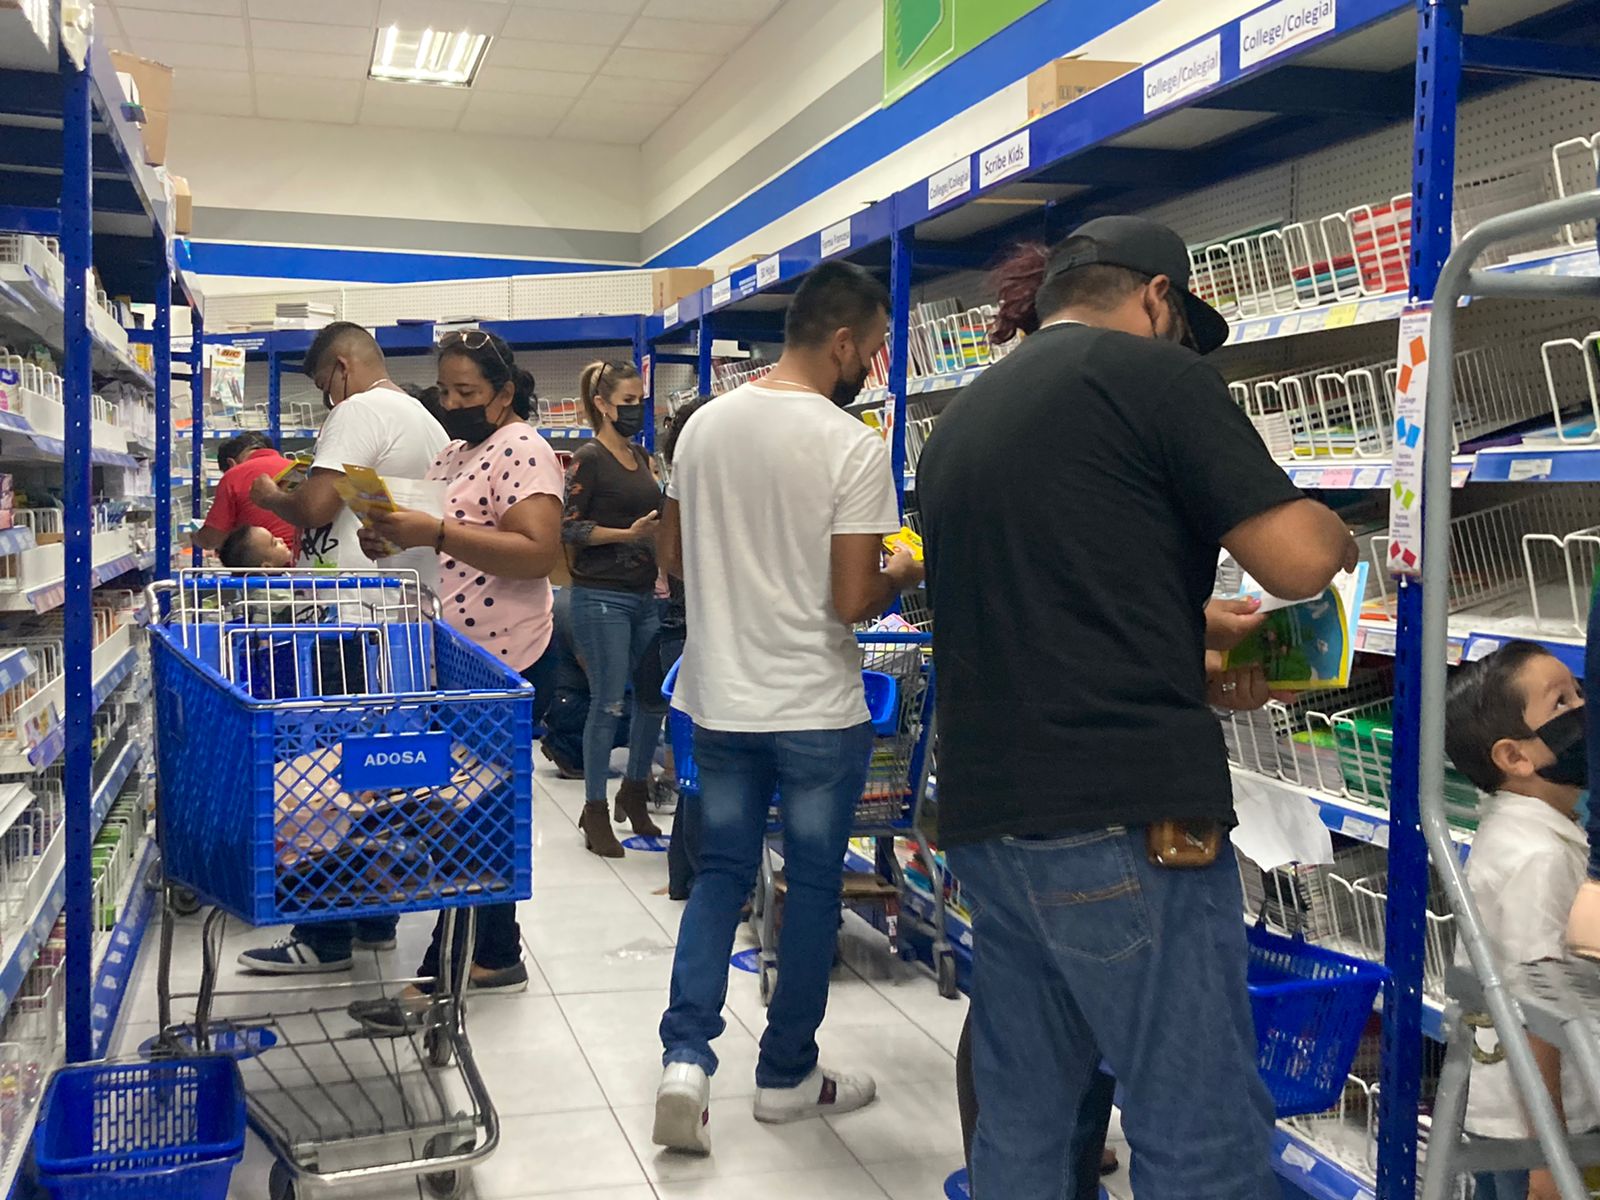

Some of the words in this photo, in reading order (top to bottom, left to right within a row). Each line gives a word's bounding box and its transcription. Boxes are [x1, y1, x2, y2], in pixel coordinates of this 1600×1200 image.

[1242, 1, 1333, 53] College/Colegial
[1146, 51, 1219, 99] College/Colegial
[984, 155, 1007, 176] Scribe
[1008, 144, 1024, 165] Kids
[363, 750, 427, 767] ADOSA
